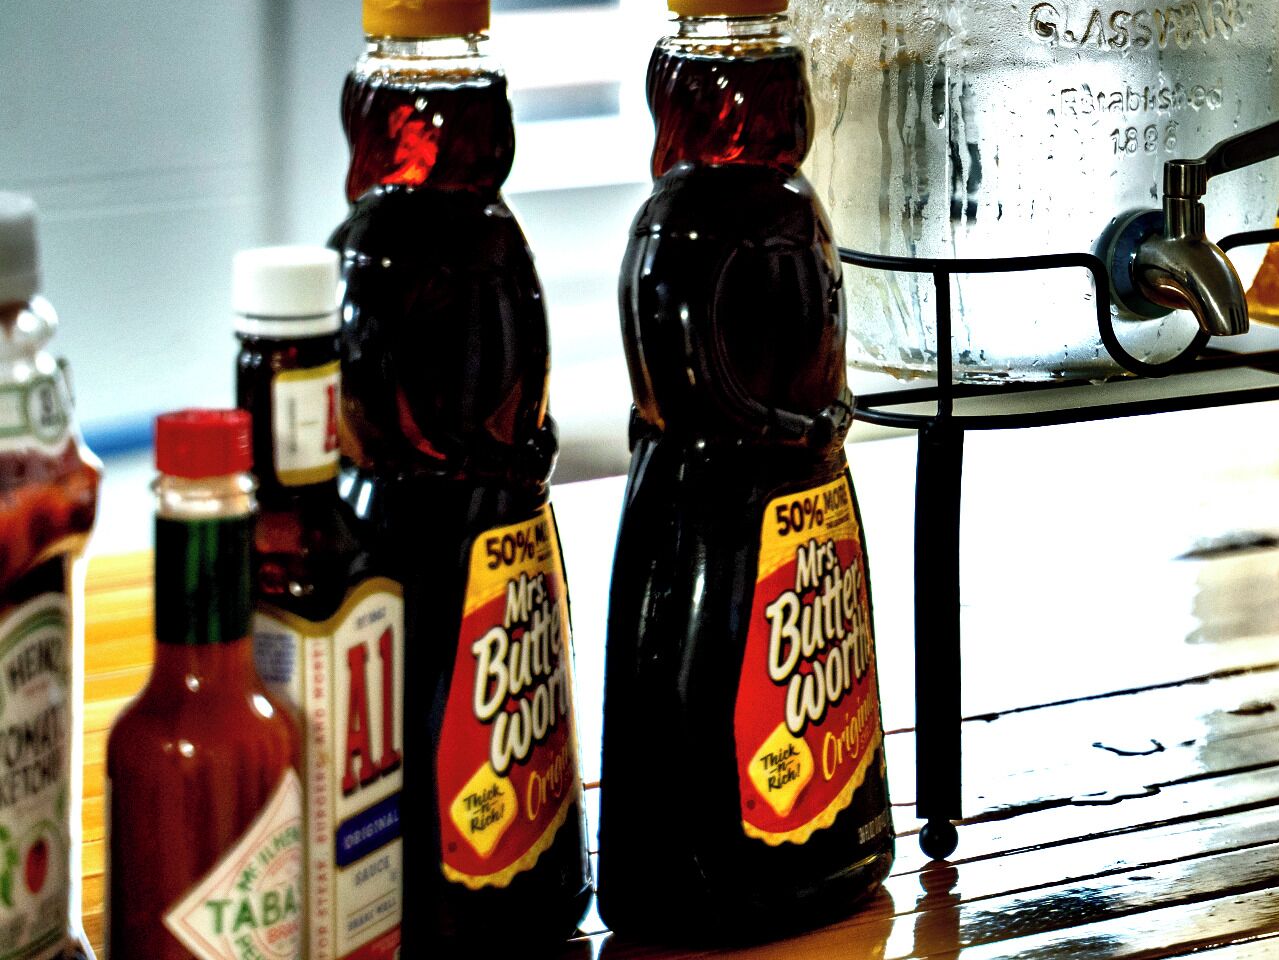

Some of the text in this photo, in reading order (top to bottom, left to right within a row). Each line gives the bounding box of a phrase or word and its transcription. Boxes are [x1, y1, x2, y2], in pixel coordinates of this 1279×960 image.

[776, 494, 824, 536] 50%
[486, 526, 535, 571] 50%
[795, 539, 838, 594] Mrs.
[760, 744, 801, 772] Thick
